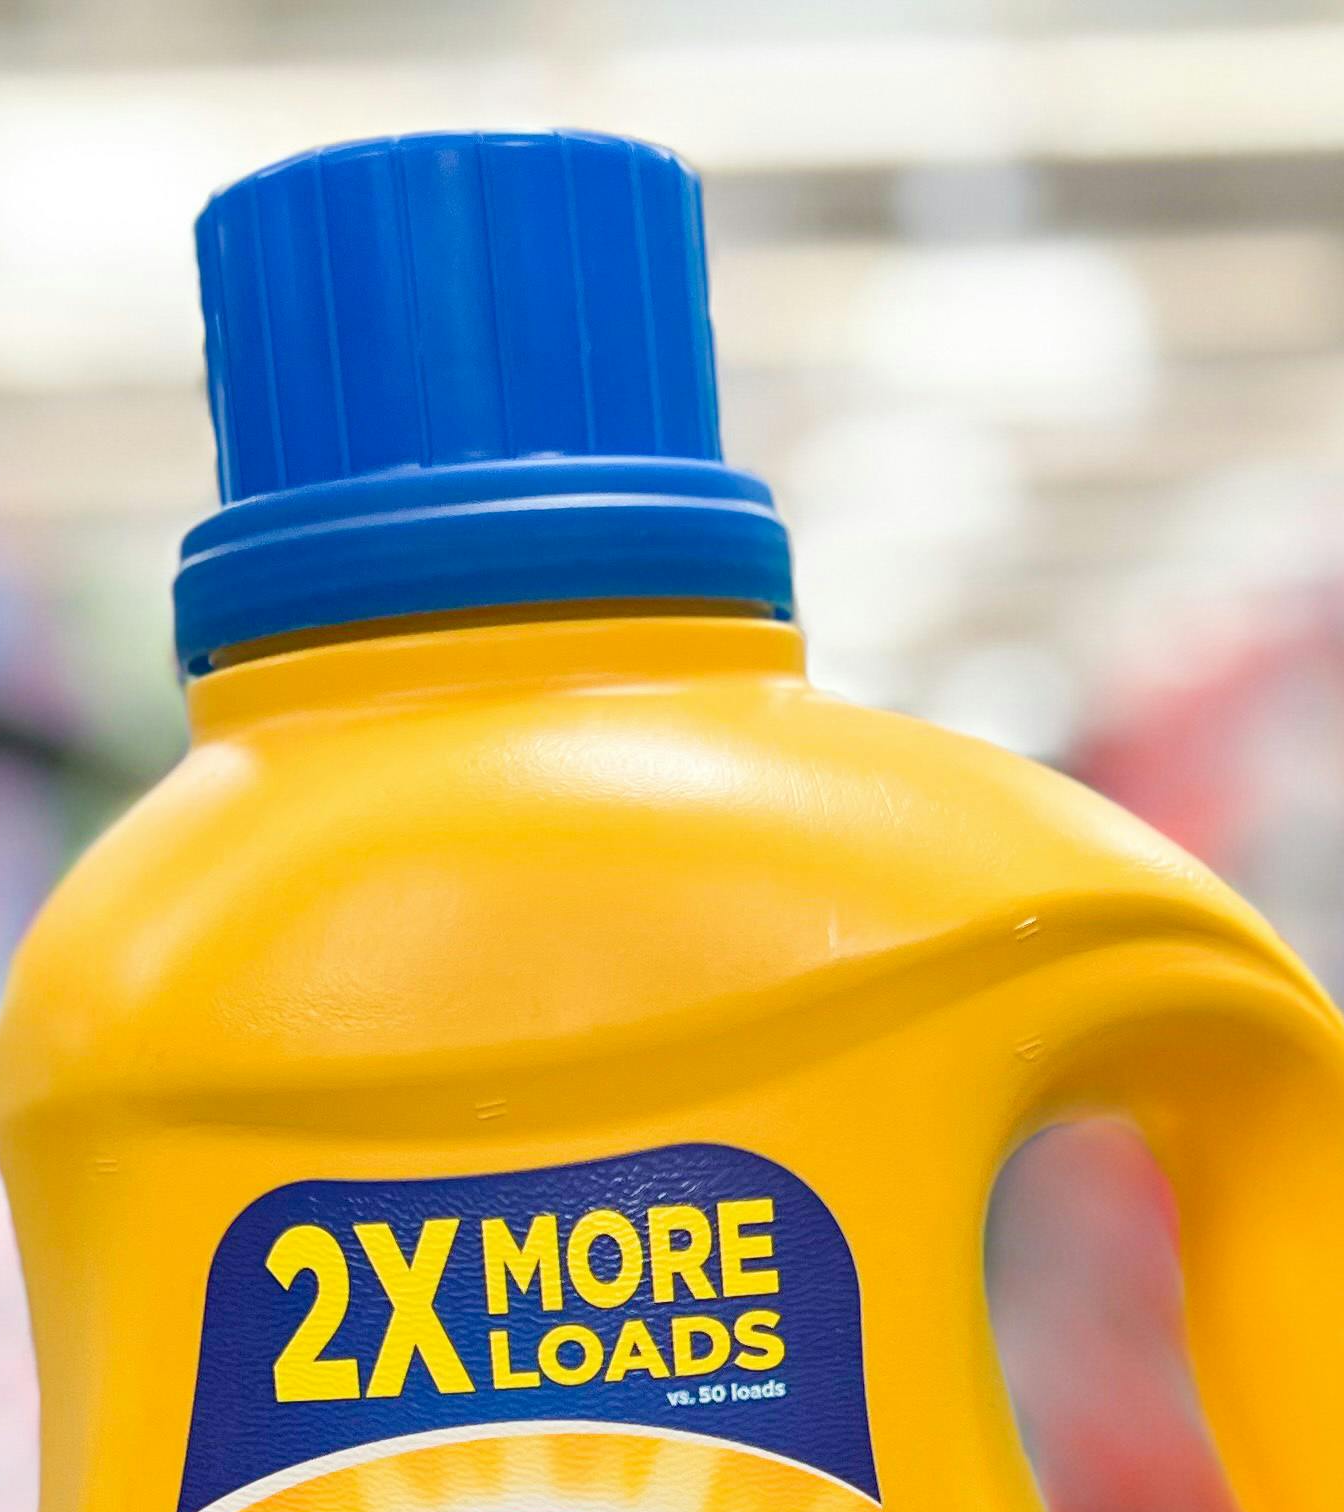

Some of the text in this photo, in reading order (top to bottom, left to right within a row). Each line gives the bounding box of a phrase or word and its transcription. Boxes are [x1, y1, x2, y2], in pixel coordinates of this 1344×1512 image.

[265, 1198, 779, 1403] 2X MORE
[490, 1310, 785, 1391] LOADS
[666, 1379, 787, 1407] vs. 50 loads
